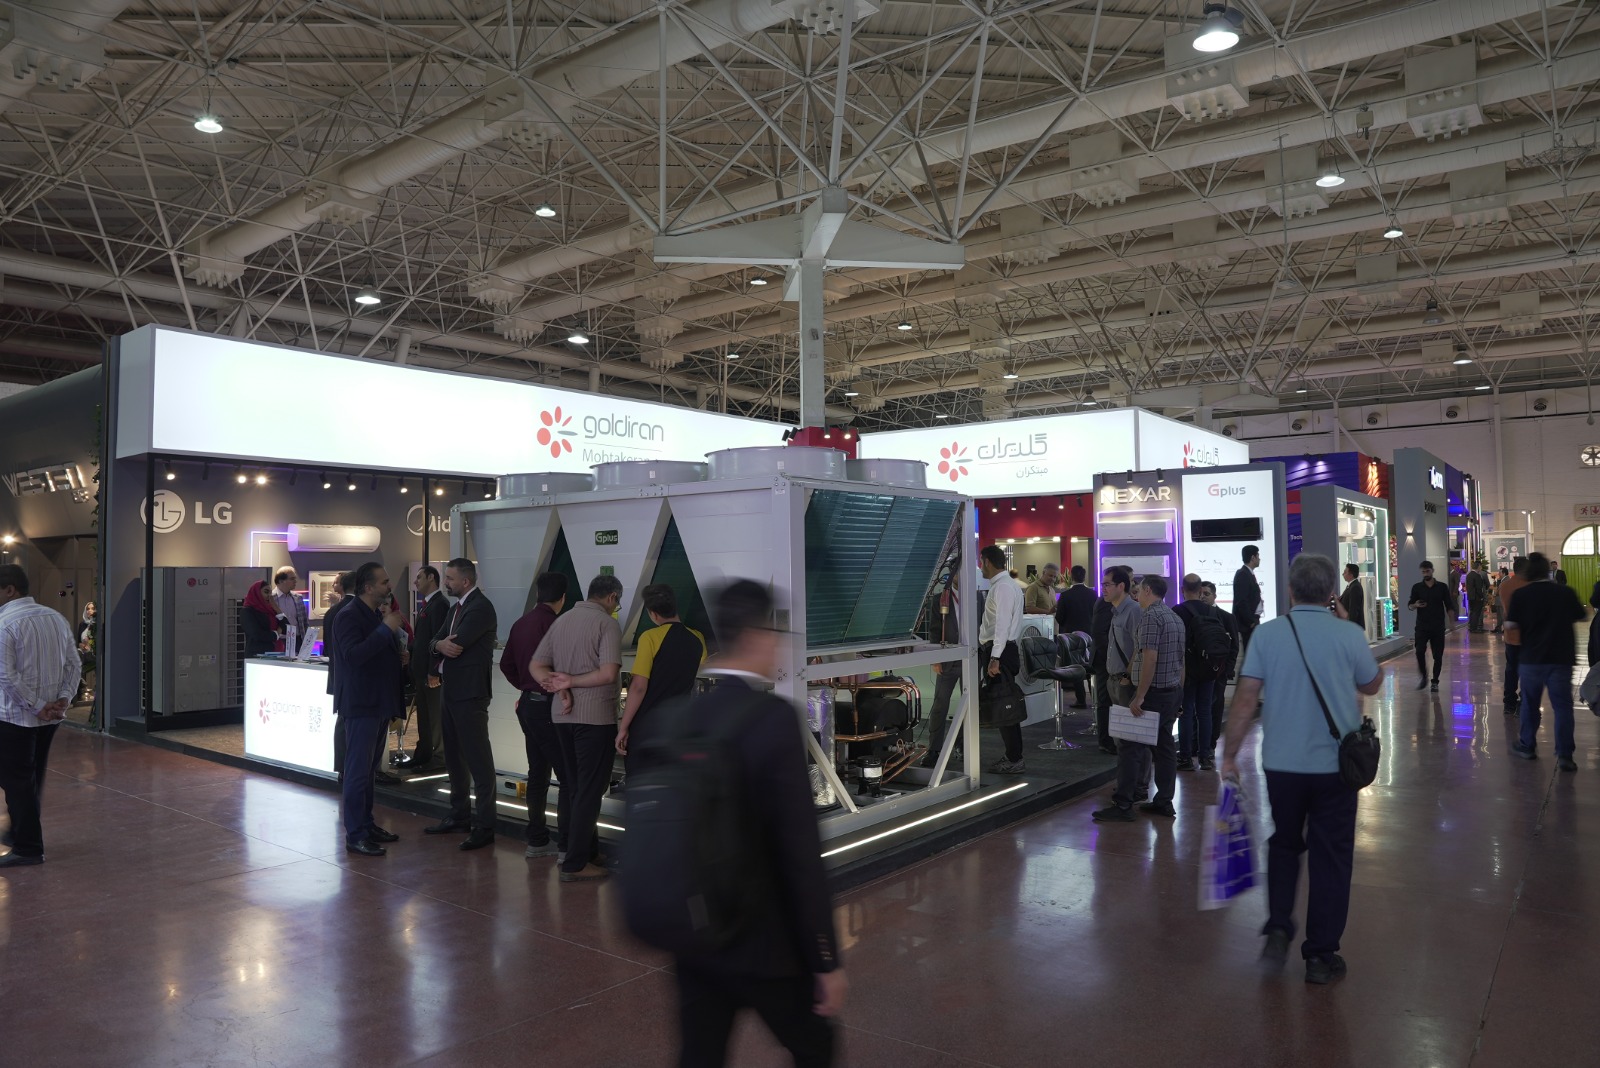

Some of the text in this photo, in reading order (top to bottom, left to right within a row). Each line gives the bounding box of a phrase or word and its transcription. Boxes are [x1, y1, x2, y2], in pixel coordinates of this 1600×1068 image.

[583, 413, 664, 442] goldiran
[582, 448, 650, 463] Mohtake
[1016, 465, 1049, 479] مبتکران
[1100, 486, 1172, 505] NEXAR
[1207, 483, 1247, 498] Gplus
[195, 501, 232, 524] LG
[595, 532, 618, 544] Gplus
